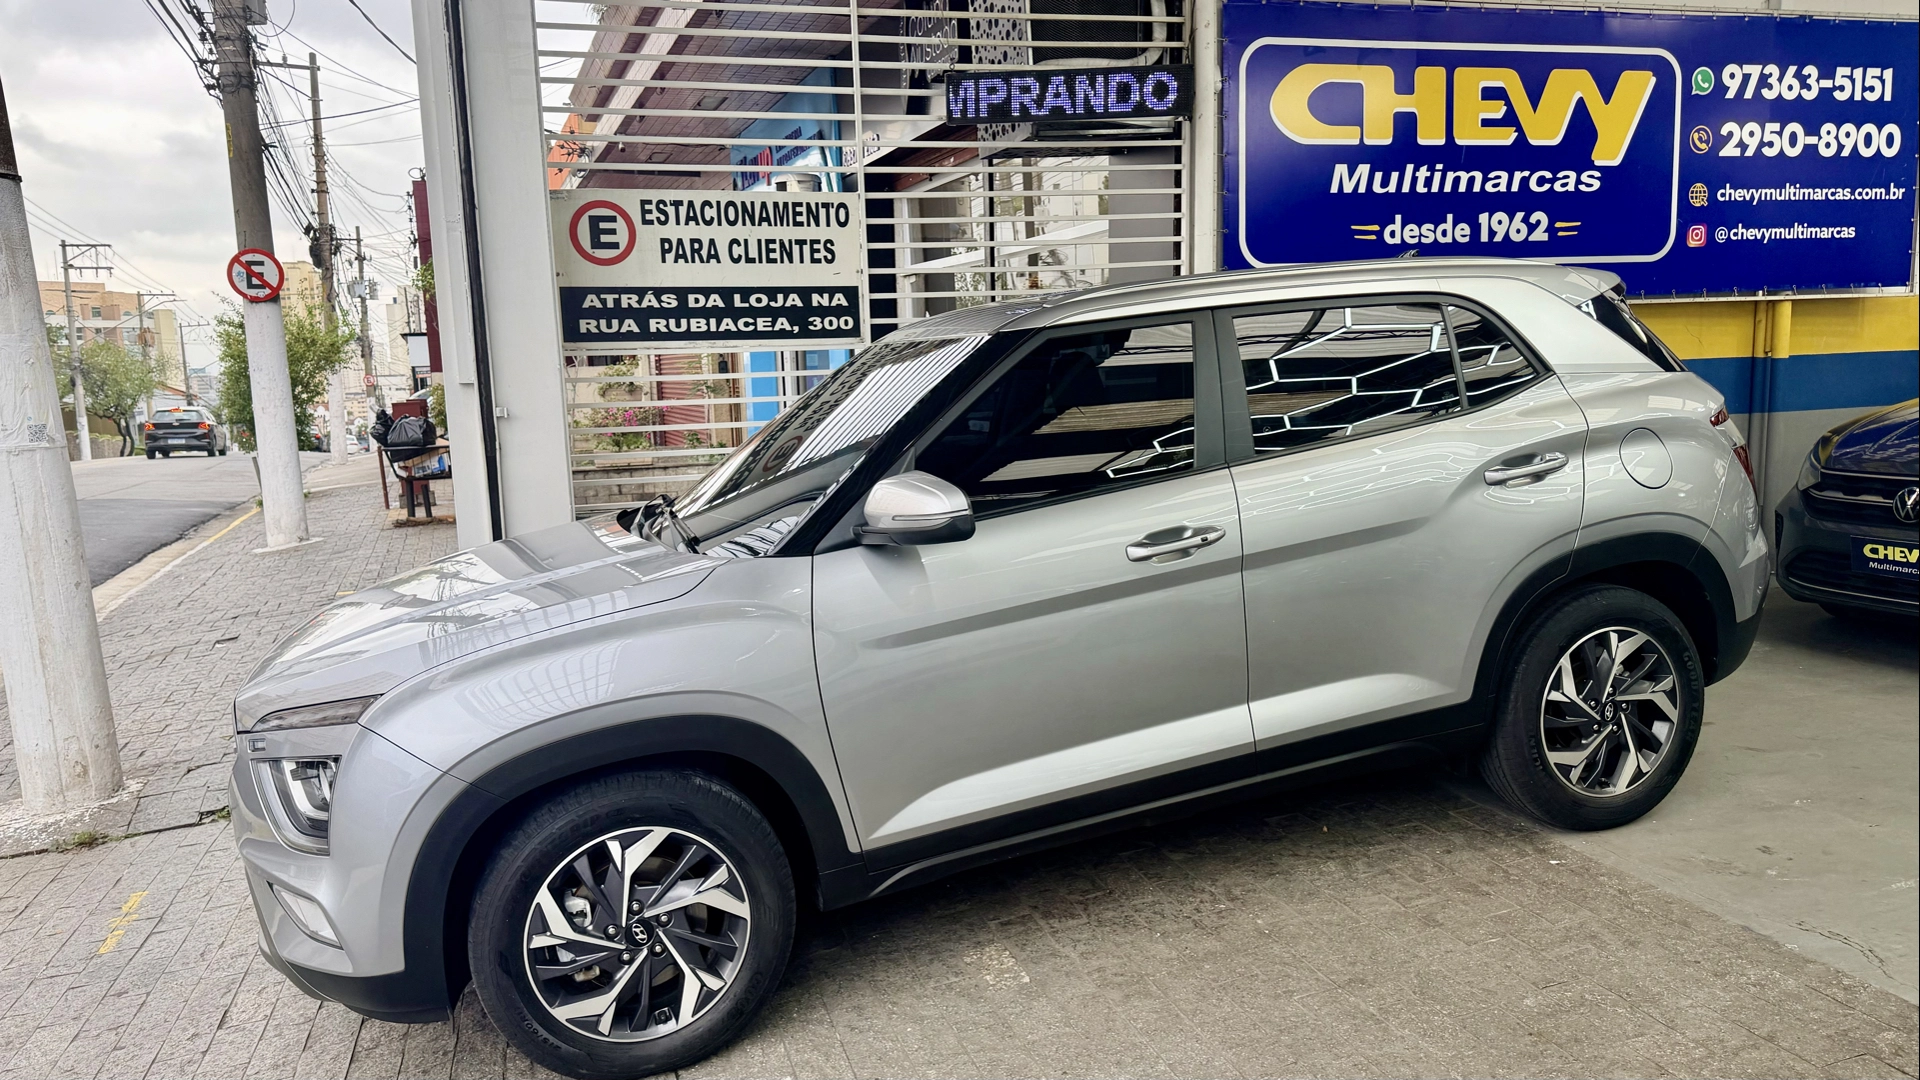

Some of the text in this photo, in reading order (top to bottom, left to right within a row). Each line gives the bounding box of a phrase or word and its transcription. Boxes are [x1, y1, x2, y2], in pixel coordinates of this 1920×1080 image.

[1722, 63, 1893, 102] 97363-5151
[1270, 63, 1656, 166] CHEVY
[1719, 121, 1902, 158] 2950-8900
[1330, 163, 1601, 194] Multimarcas
[1716, 182, 1906, 206] chevymultimarcas.com.br
[640, 199, 850, 228] ESTACIONAMENTO
[1383, 211, 1549, 245] desde 1962
[588, 215, 620, 250] E
[660, 237, 836, 264] PARA CLIENTES
[582, 291, 849, 308] ATRÁS DA LOJA NA
[579, 316, 854, 334] RUA RUBIACEA, 300
[1868, 561, 1919, 575] Multimarc
